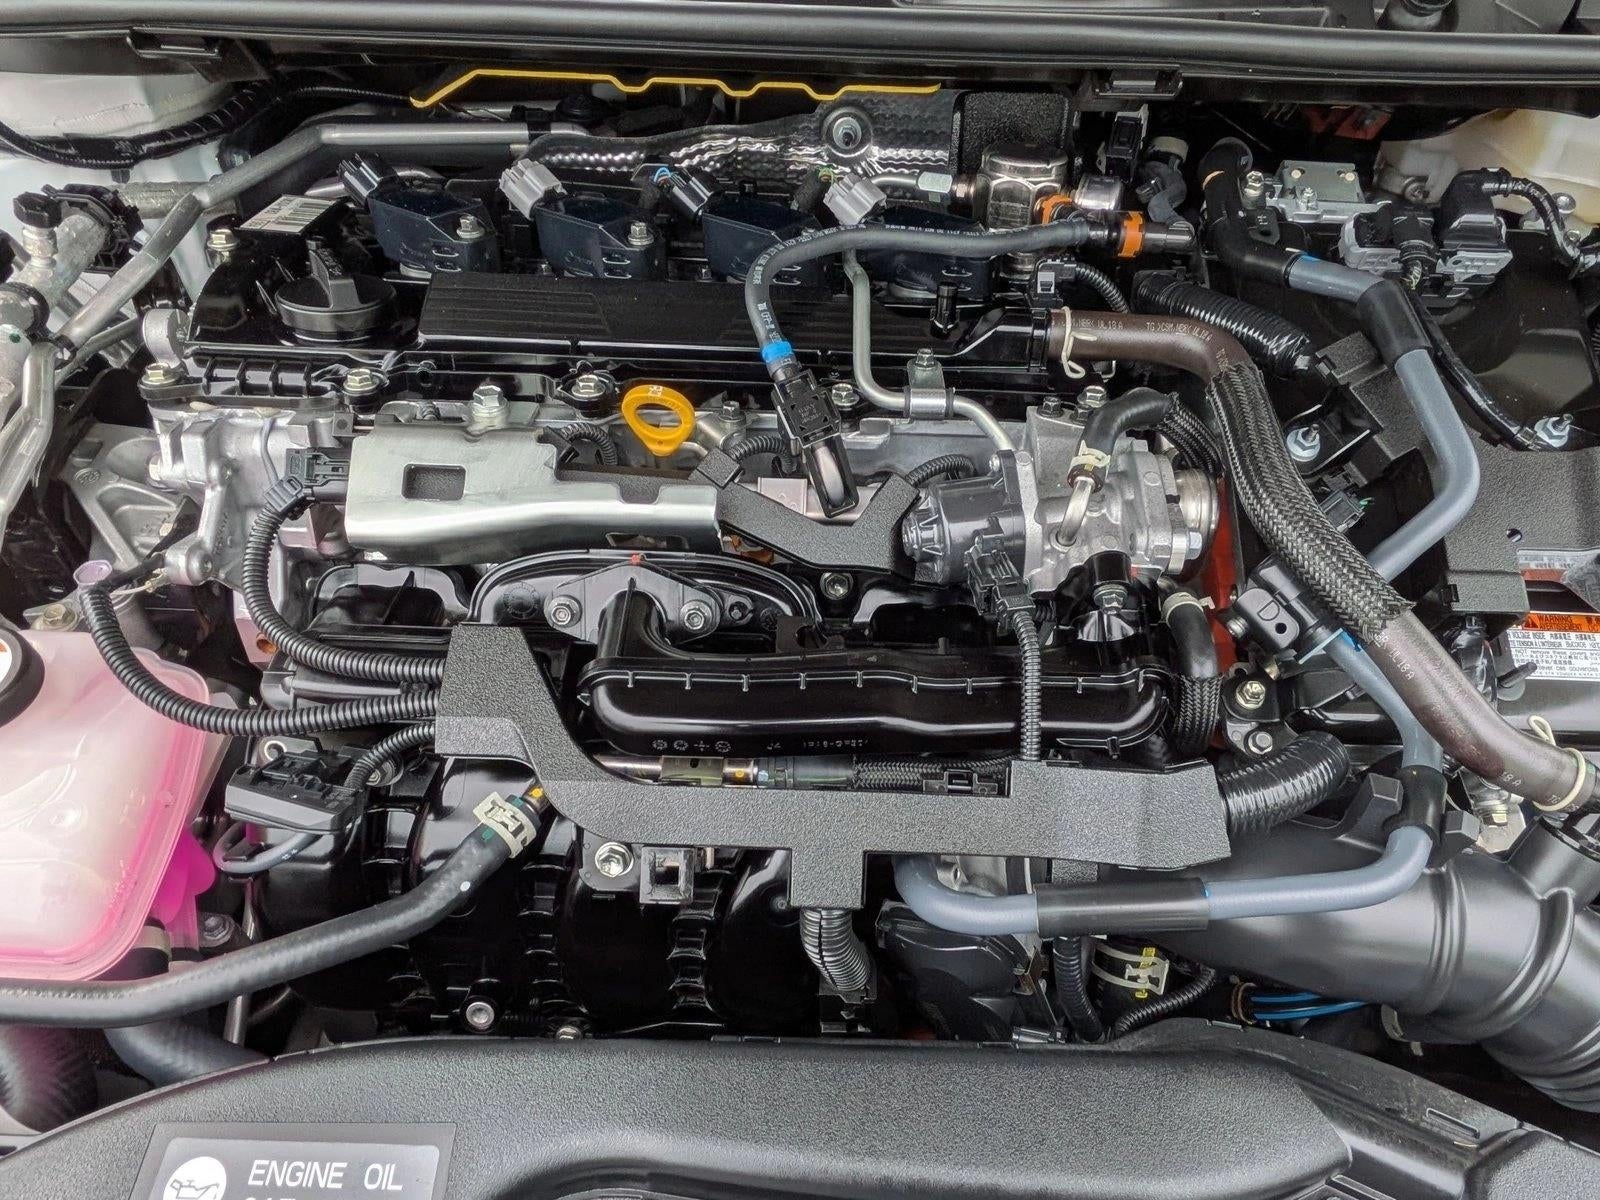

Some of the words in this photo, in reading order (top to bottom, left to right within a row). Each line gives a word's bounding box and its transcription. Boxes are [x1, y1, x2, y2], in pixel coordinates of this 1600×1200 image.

[1537, 614, 1573, 623] WARNING
[248, 1159, 347, 1188] ENGINE
[363, 1162, 403, 1191] OIL
